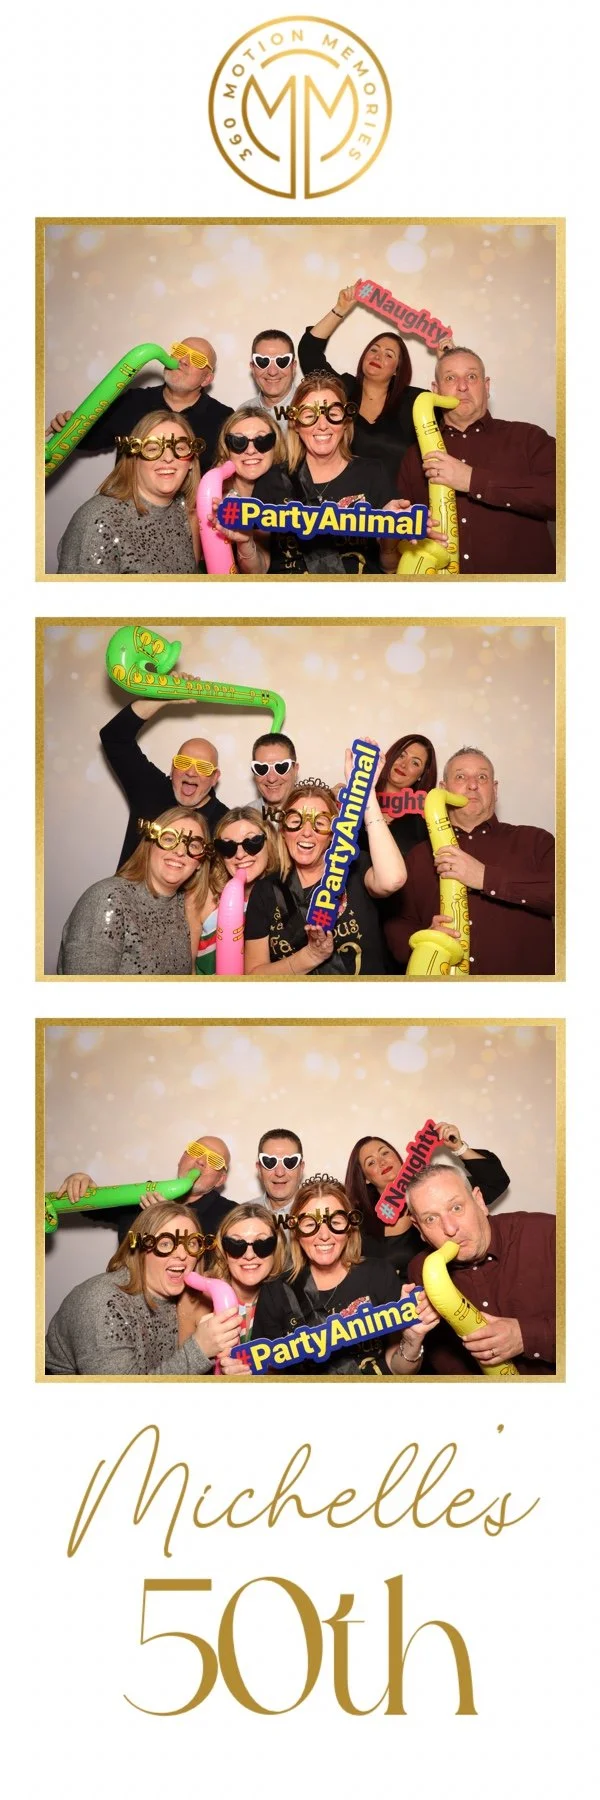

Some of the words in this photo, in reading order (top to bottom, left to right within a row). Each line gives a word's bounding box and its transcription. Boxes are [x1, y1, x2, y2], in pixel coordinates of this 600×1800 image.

[358, 283, 449, 344] #Naughty
[221, 501, 424, 535] #PartyAnimal
[311, 743, 378, 928] #PartyAnimal
[379, 1122, 440, 1220] #Naughty
